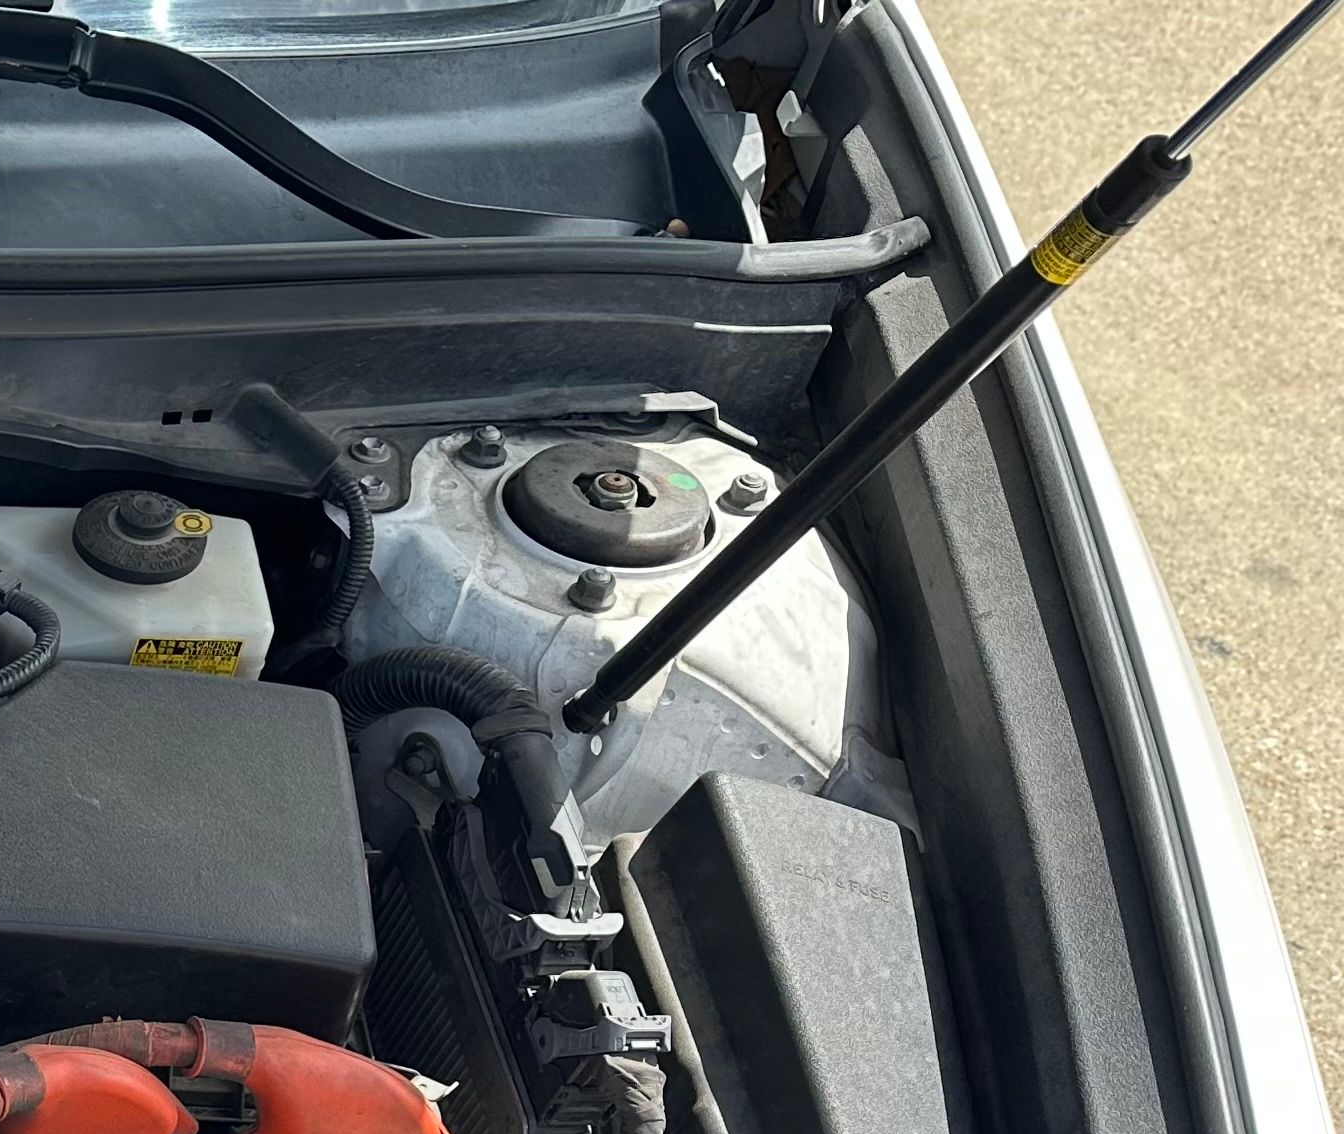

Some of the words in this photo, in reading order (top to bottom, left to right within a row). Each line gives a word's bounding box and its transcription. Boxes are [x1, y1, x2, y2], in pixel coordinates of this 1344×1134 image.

[196, 640, 238, 649] CAUTION
[183, 647, 235, 656] ATTENTION
[848, 879, 894, 904] FUSE
